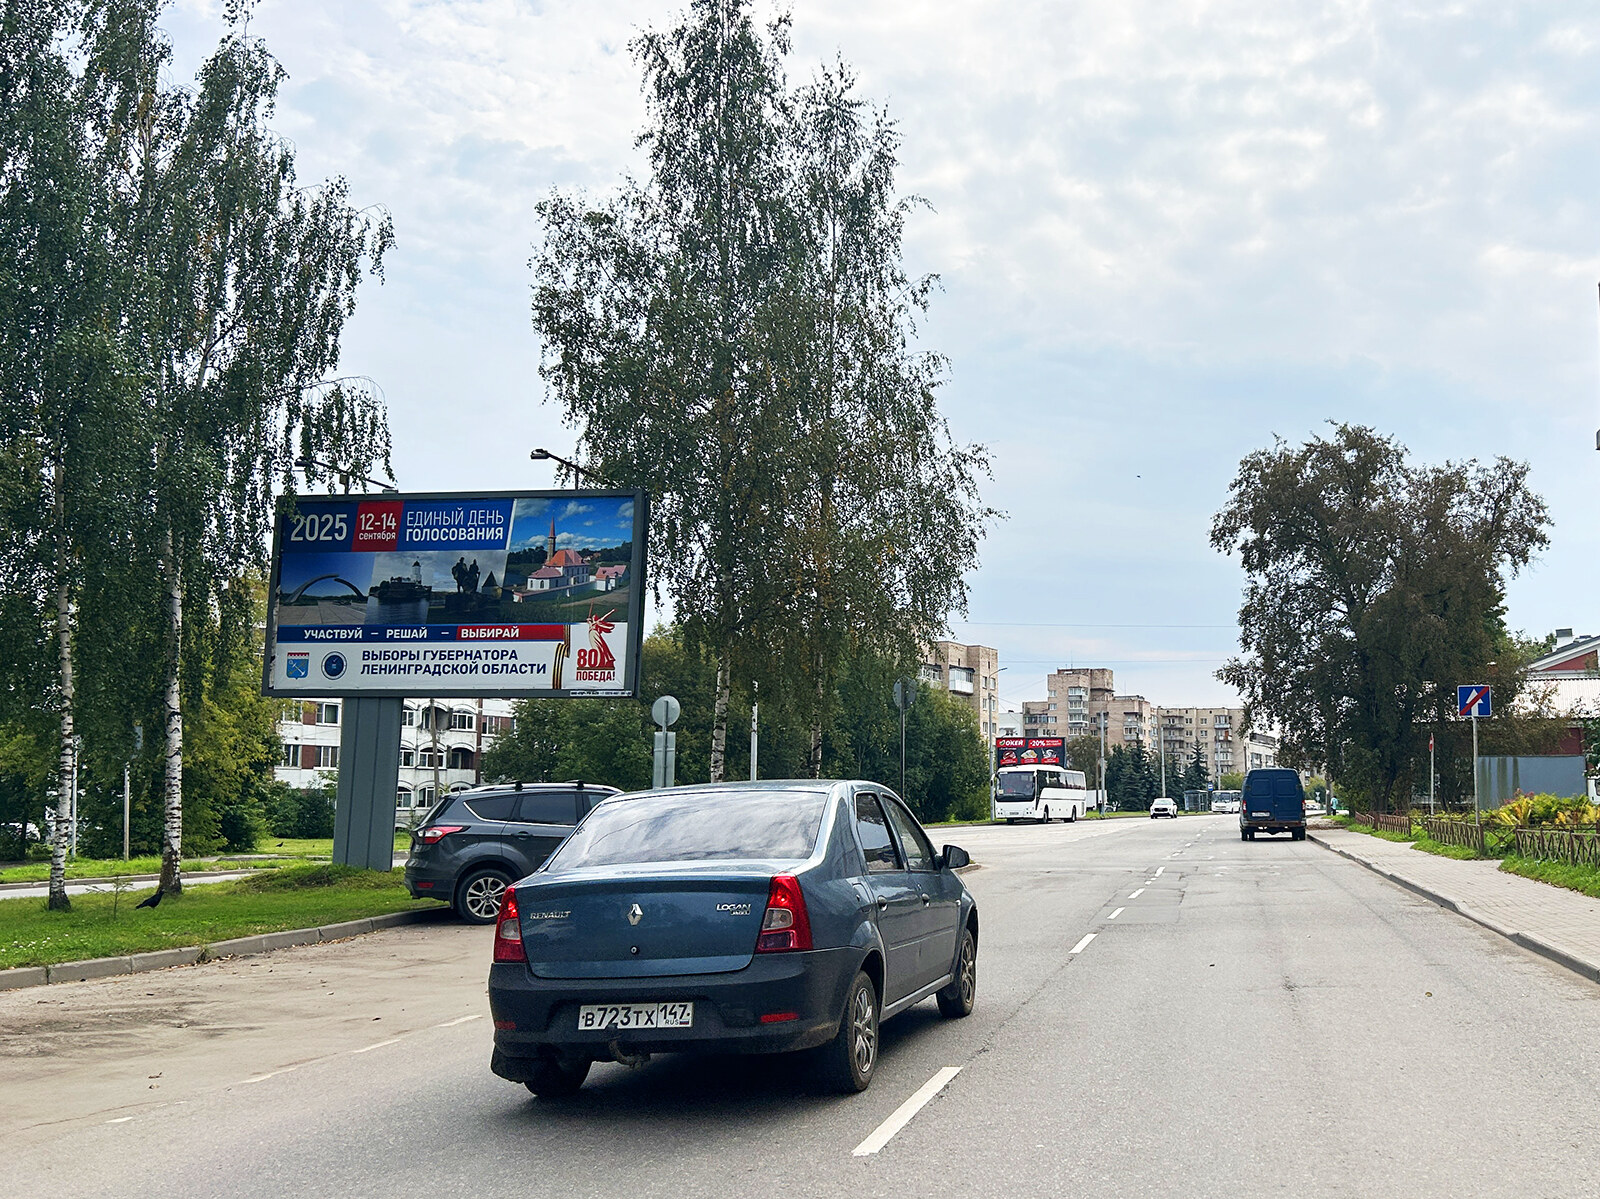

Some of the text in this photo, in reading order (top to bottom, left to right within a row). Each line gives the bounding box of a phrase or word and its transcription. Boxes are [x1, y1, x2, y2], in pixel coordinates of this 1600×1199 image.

[360, 512, 397, 531] 12-14
[406, 507, 504, 527] ЕДИНЫЙ ДЕНЬ
[290, 513, 348, 541] 2025
[359, 531, 396, 541] сентября
[304, 628, 363, 639] УЧАСТВУЙ
[386, 627, 428, 639] РЕШАЙ
[461, 626, 519, 639] ВЫБИРАЙ
[362, 649, 518, 661] ВЫБОРЫ ГУБЕРНАТОРА
[577, 648, 599, 668] 80
[361, 661, 547, 676] ЛЕНИНГРАДСКОЙ ОБЛАСТИ
[576, 671, 615, 682] ПОБЕДА!
[716, 903, 751, 911] LOGAN
[530, 910, 572, 920] RENAULT
[659, 1004, 688, 1020] 147
